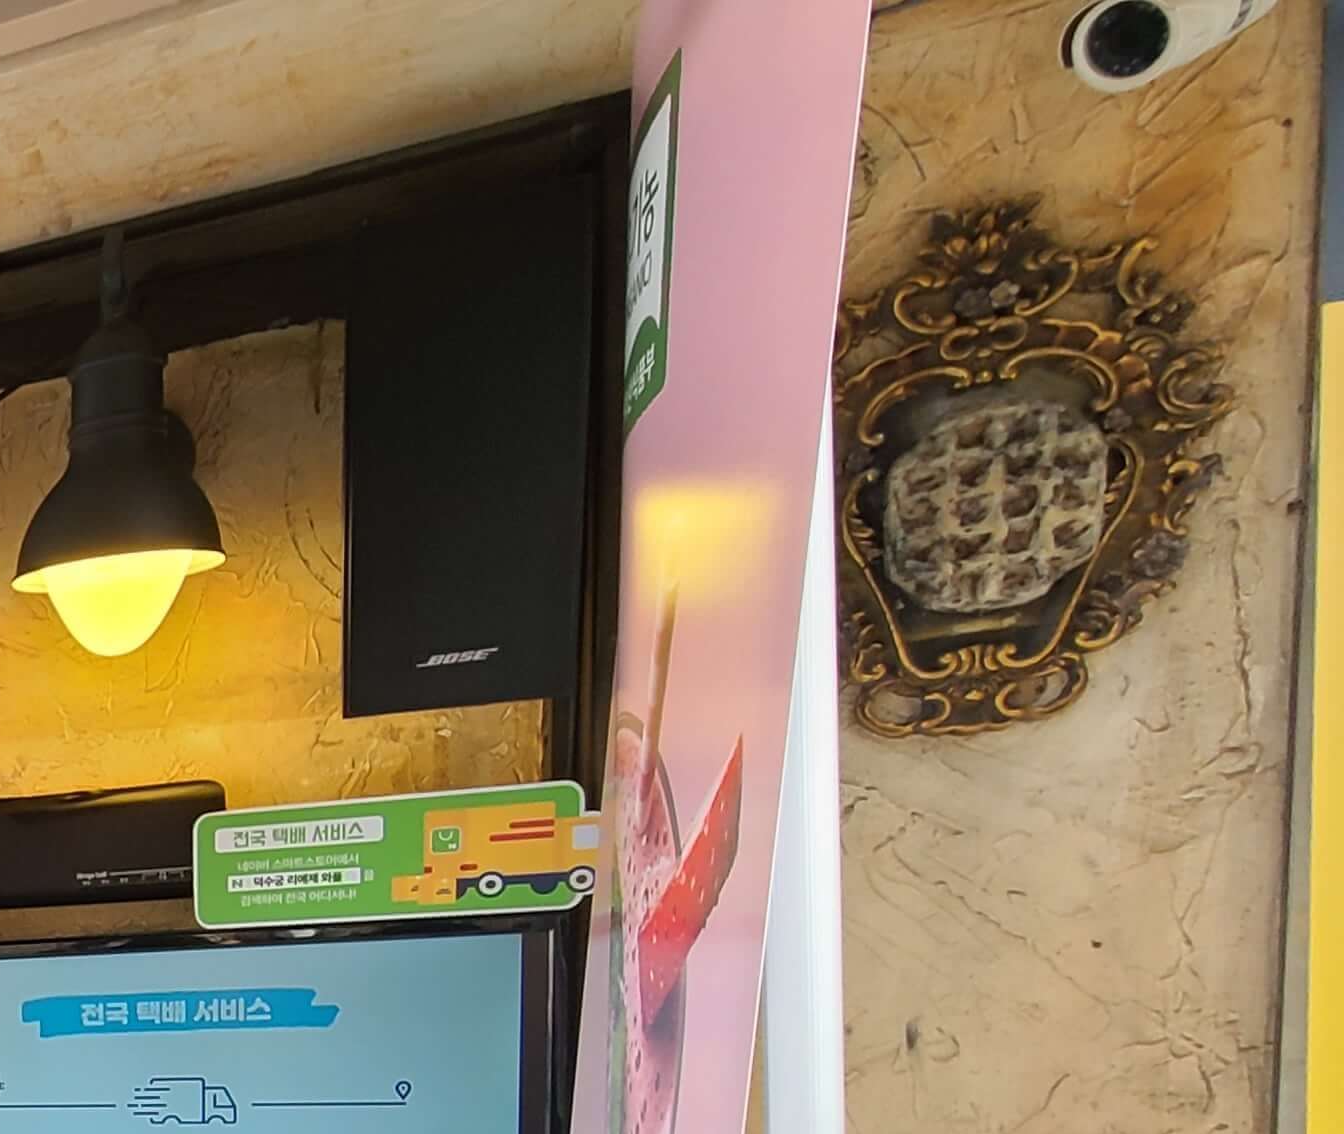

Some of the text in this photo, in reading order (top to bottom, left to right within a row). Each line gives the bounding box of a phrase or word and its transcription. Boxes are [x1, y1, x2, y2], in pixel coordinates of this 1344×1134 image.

[415, 647, 499, 668] BOSE
[234, 822, 365, 848] 전국 택배 서비스
[253, 874, 284, 887] 덕수궁
[80, 997, 272, 1027] 전국 택배 서비스
